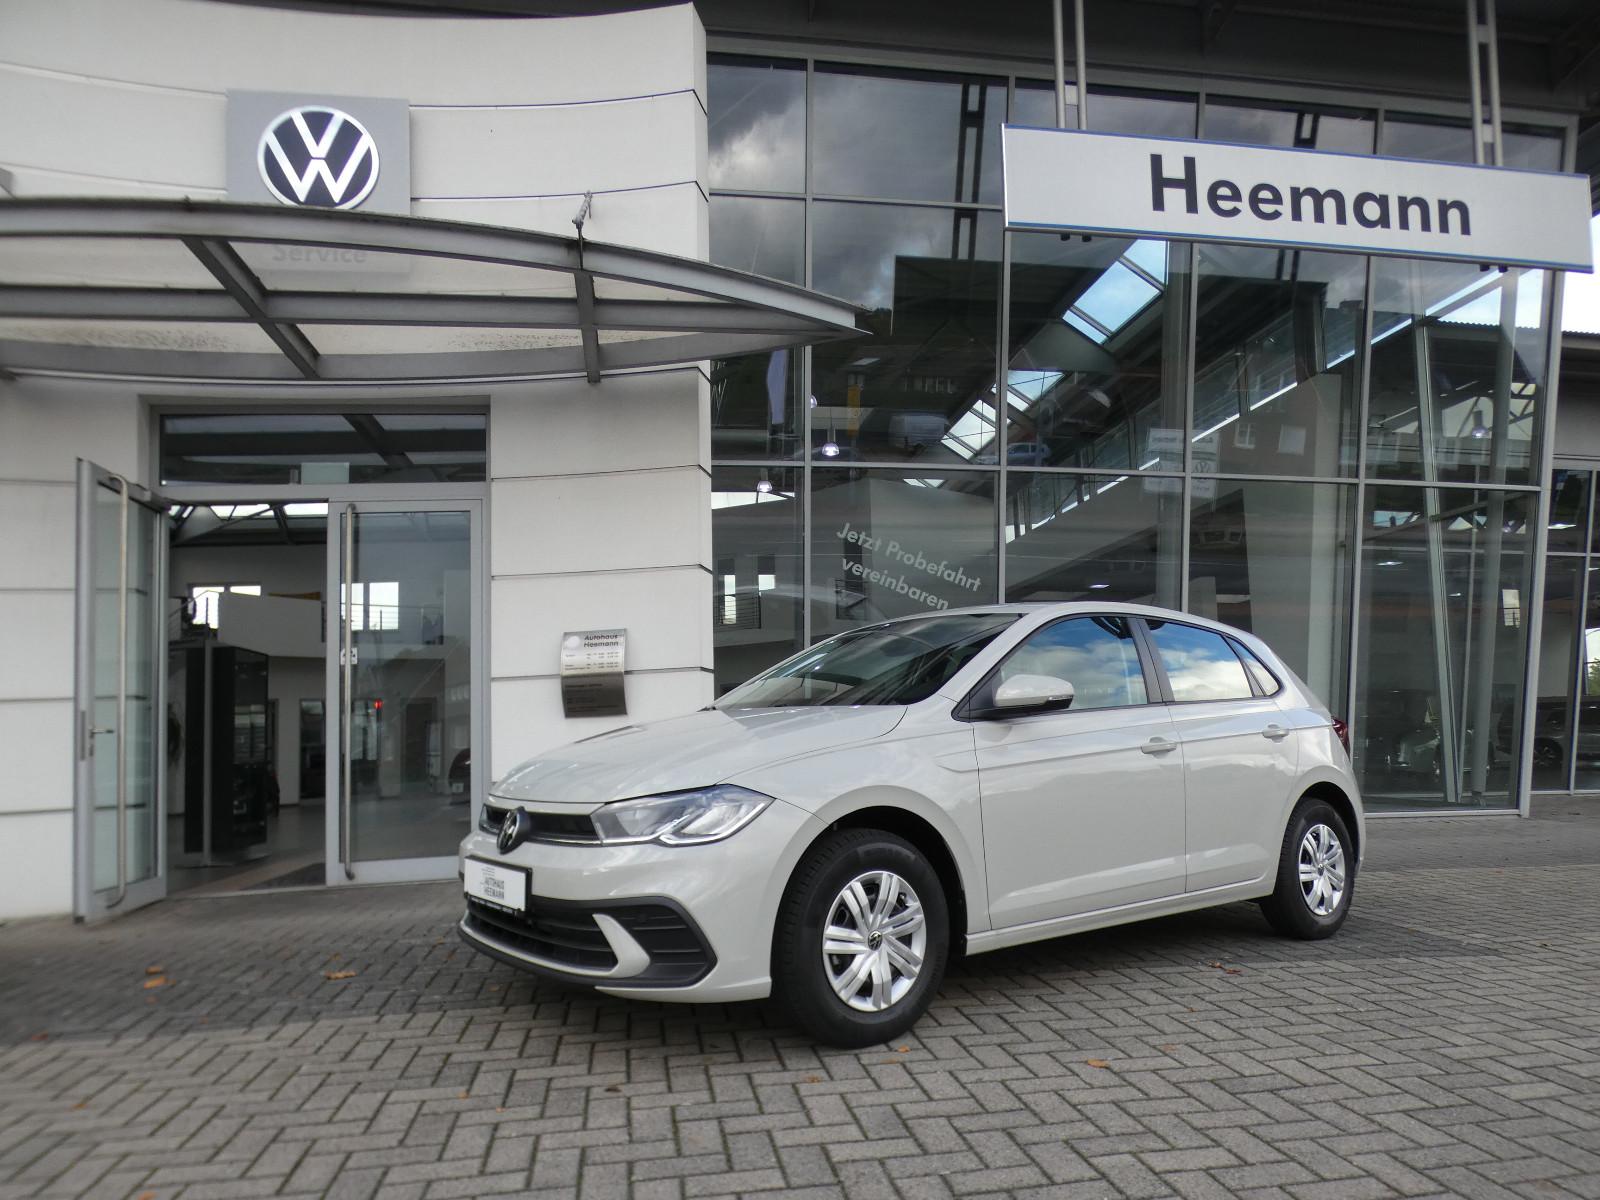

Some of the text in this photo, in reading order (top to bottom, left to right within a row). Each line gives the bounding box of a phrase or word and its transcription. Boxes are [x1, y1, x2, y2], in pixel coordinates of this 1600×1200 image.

[1150, 153, 1472, 236] Heemann
[272, 244, 367, 263] Service
[836, 522, 982, 592] Jetzt Probefahrt
[842, 558, 949, 610] vereinbaren
